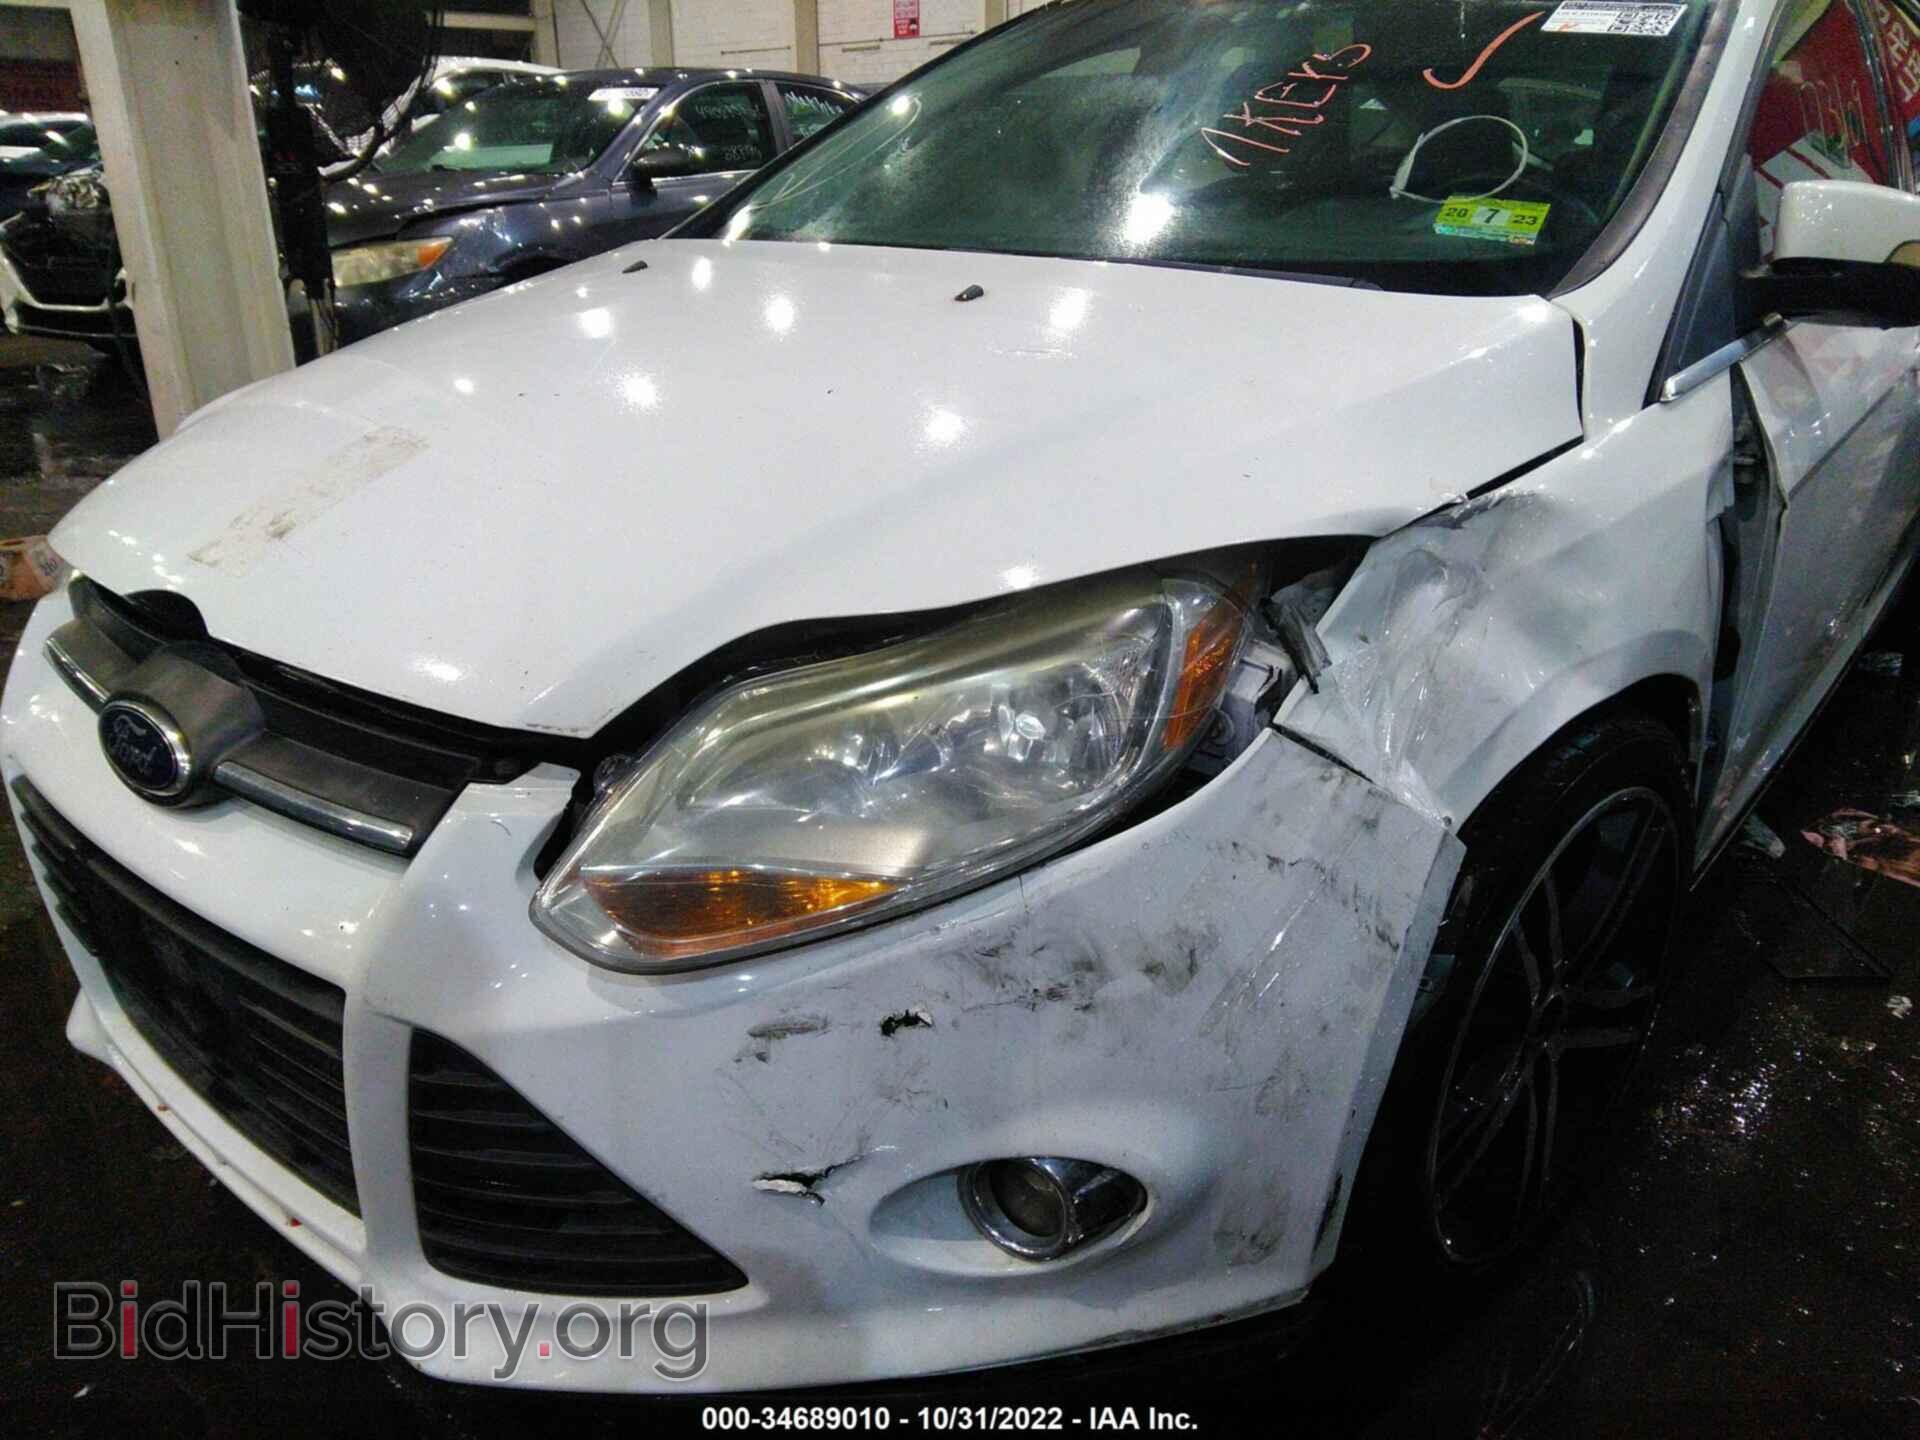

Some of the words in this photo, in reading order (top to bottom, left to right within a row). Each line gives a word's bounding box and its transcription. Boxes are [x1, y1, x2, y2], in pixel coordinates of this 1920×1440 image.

[1445, 206, 1469, 219] 20
[1483, 208, 1500, 224] 7
[1511, 214, 1538, 226] 23
